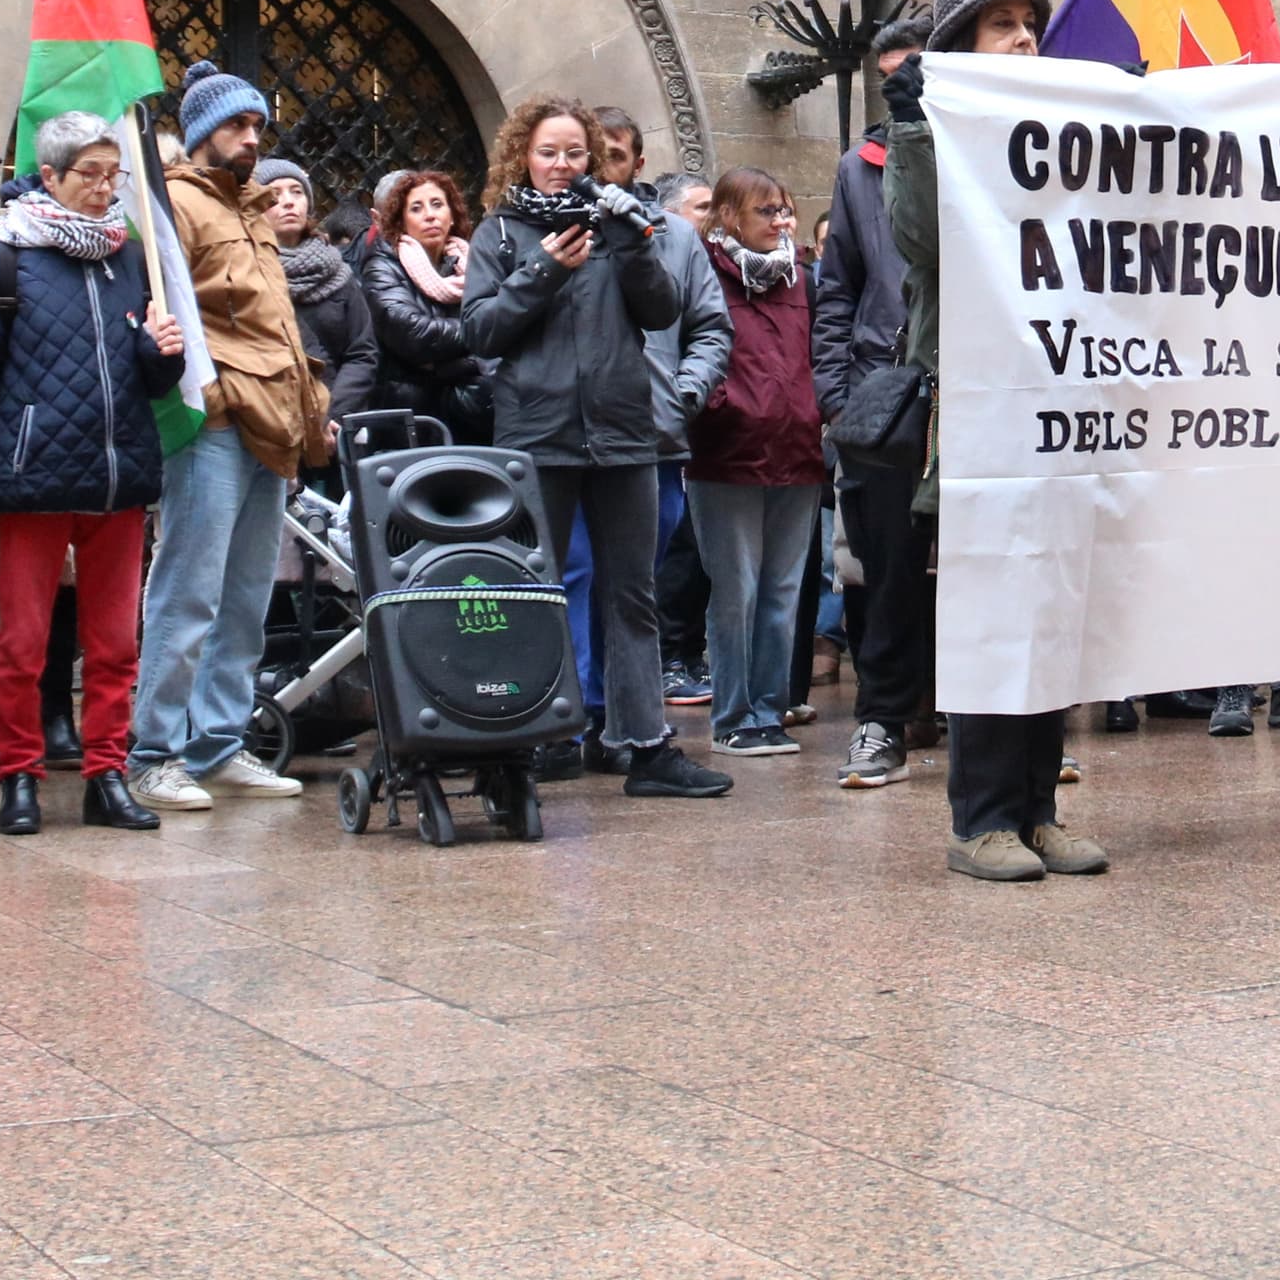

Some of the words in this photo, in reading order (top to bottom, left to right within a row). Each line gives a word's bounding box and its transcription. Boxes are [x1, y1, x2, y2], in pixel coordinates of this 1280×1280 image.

[1007, 119, 1243, 199] CONTRA
[1020, 217, 1064, 292] A
[1203, 338, 1251, 378] LA
[1035, 408, 1149, 454] DELS
